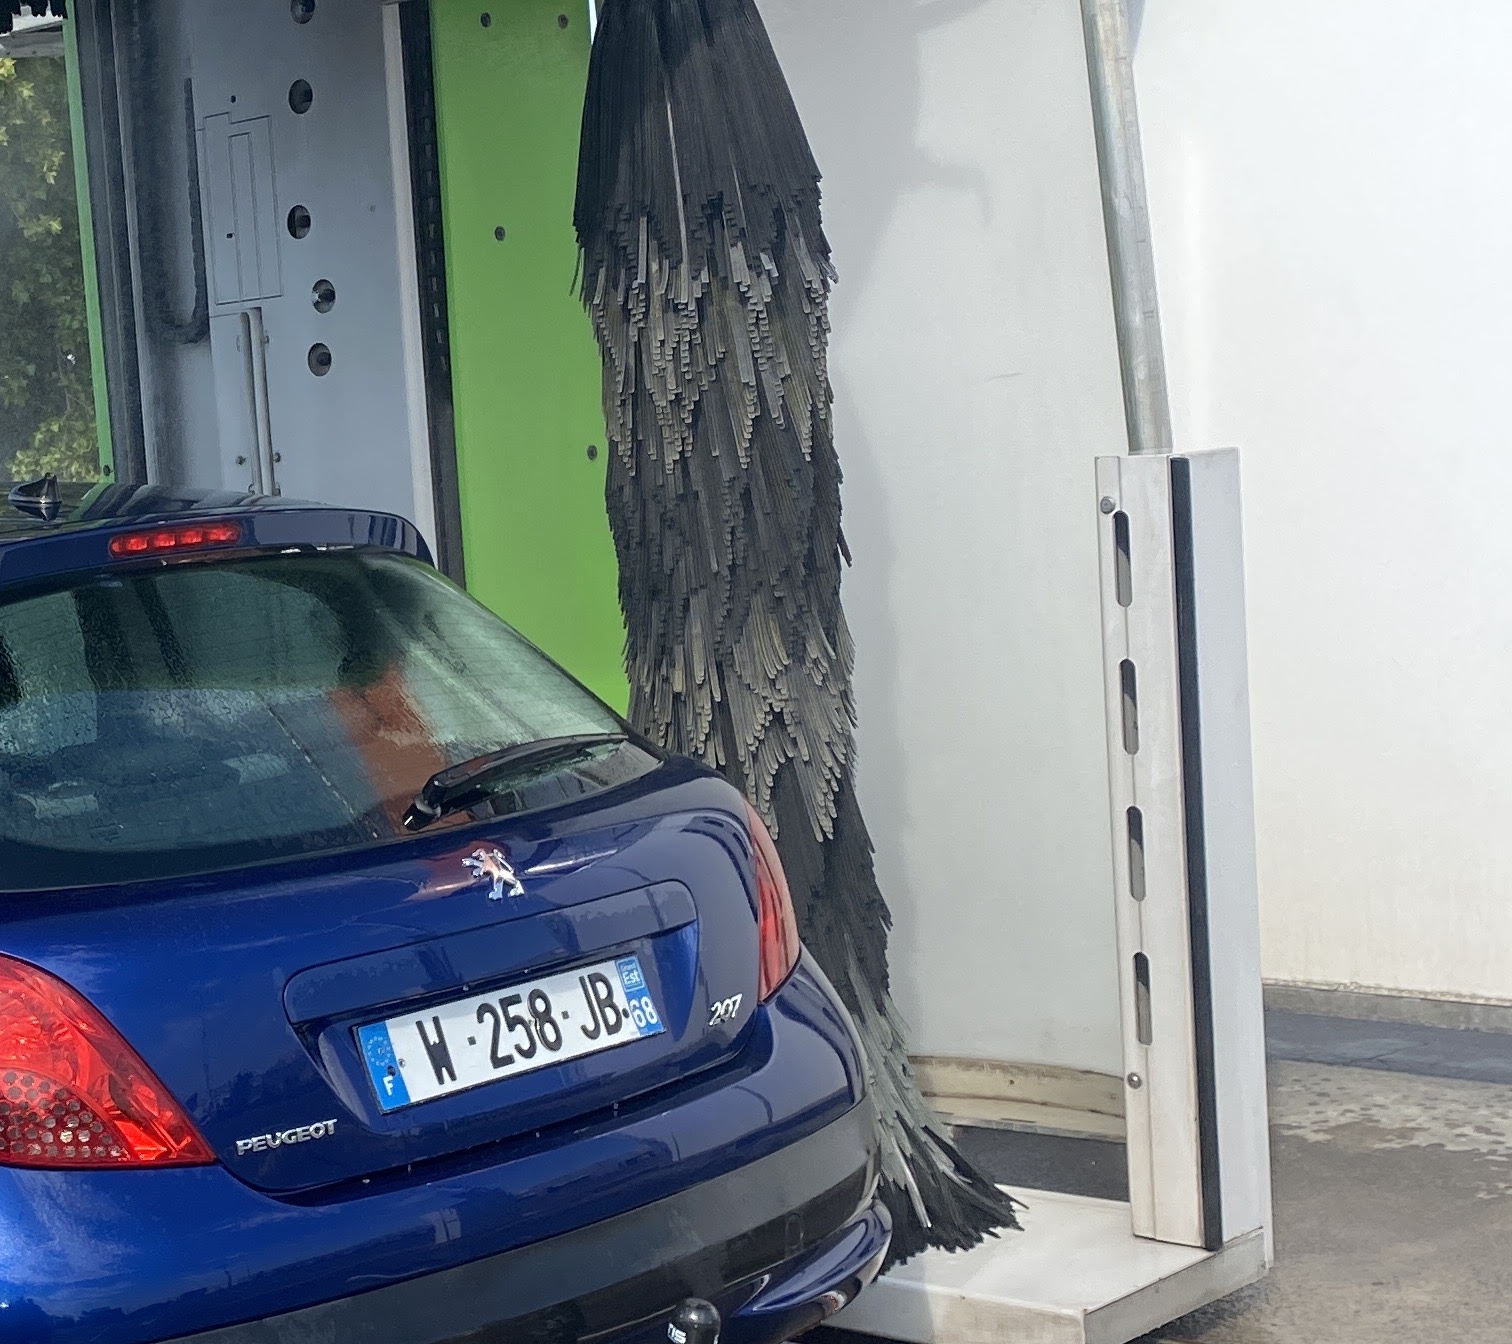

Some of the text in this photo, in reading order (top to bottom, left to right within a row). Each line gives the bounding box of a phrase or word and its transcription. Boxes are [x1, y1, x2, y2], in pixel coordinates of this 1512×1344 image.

[622, 969, 641, 986] Est
[629, 996, 658, 1028] 68
[708, 992, 743, 1026] 207
[382, 1075, 394, 1096] F
[235, 1118, 338, 1156] PEUGEOT
